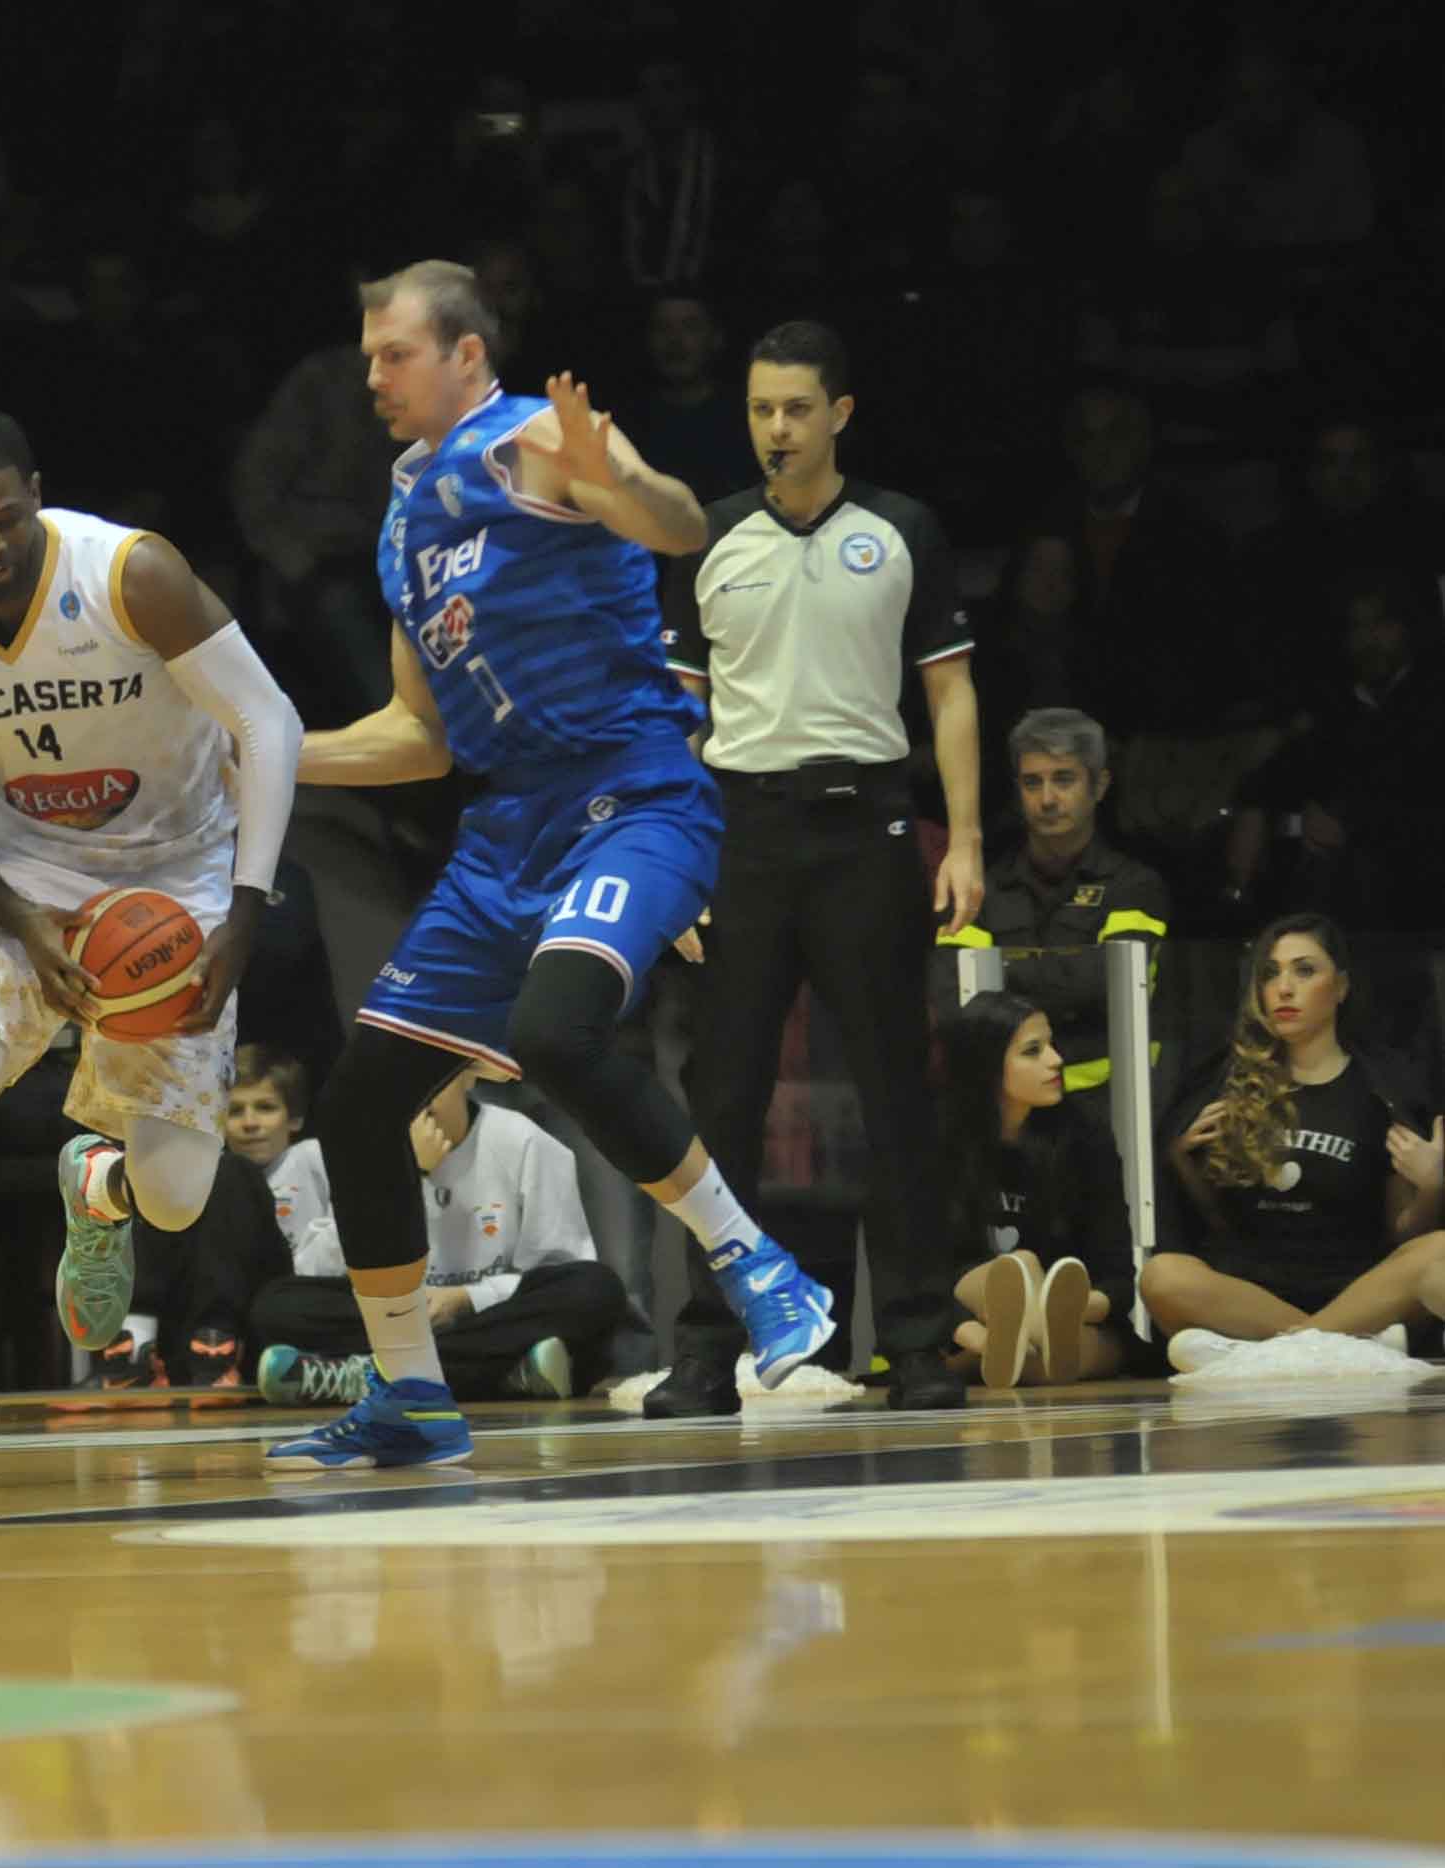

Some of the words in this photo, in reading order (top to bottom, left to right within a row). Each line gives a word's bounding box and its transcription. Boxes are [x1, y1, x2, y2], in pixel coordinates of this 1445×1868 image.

[416, 527, 489, 600] Enel
[15, 723, 63, 760] 14
[8, 774, 127, 814] REGGIA
[549, 874, 631, 923] 10
[378, 961, 418, 986] Enel
